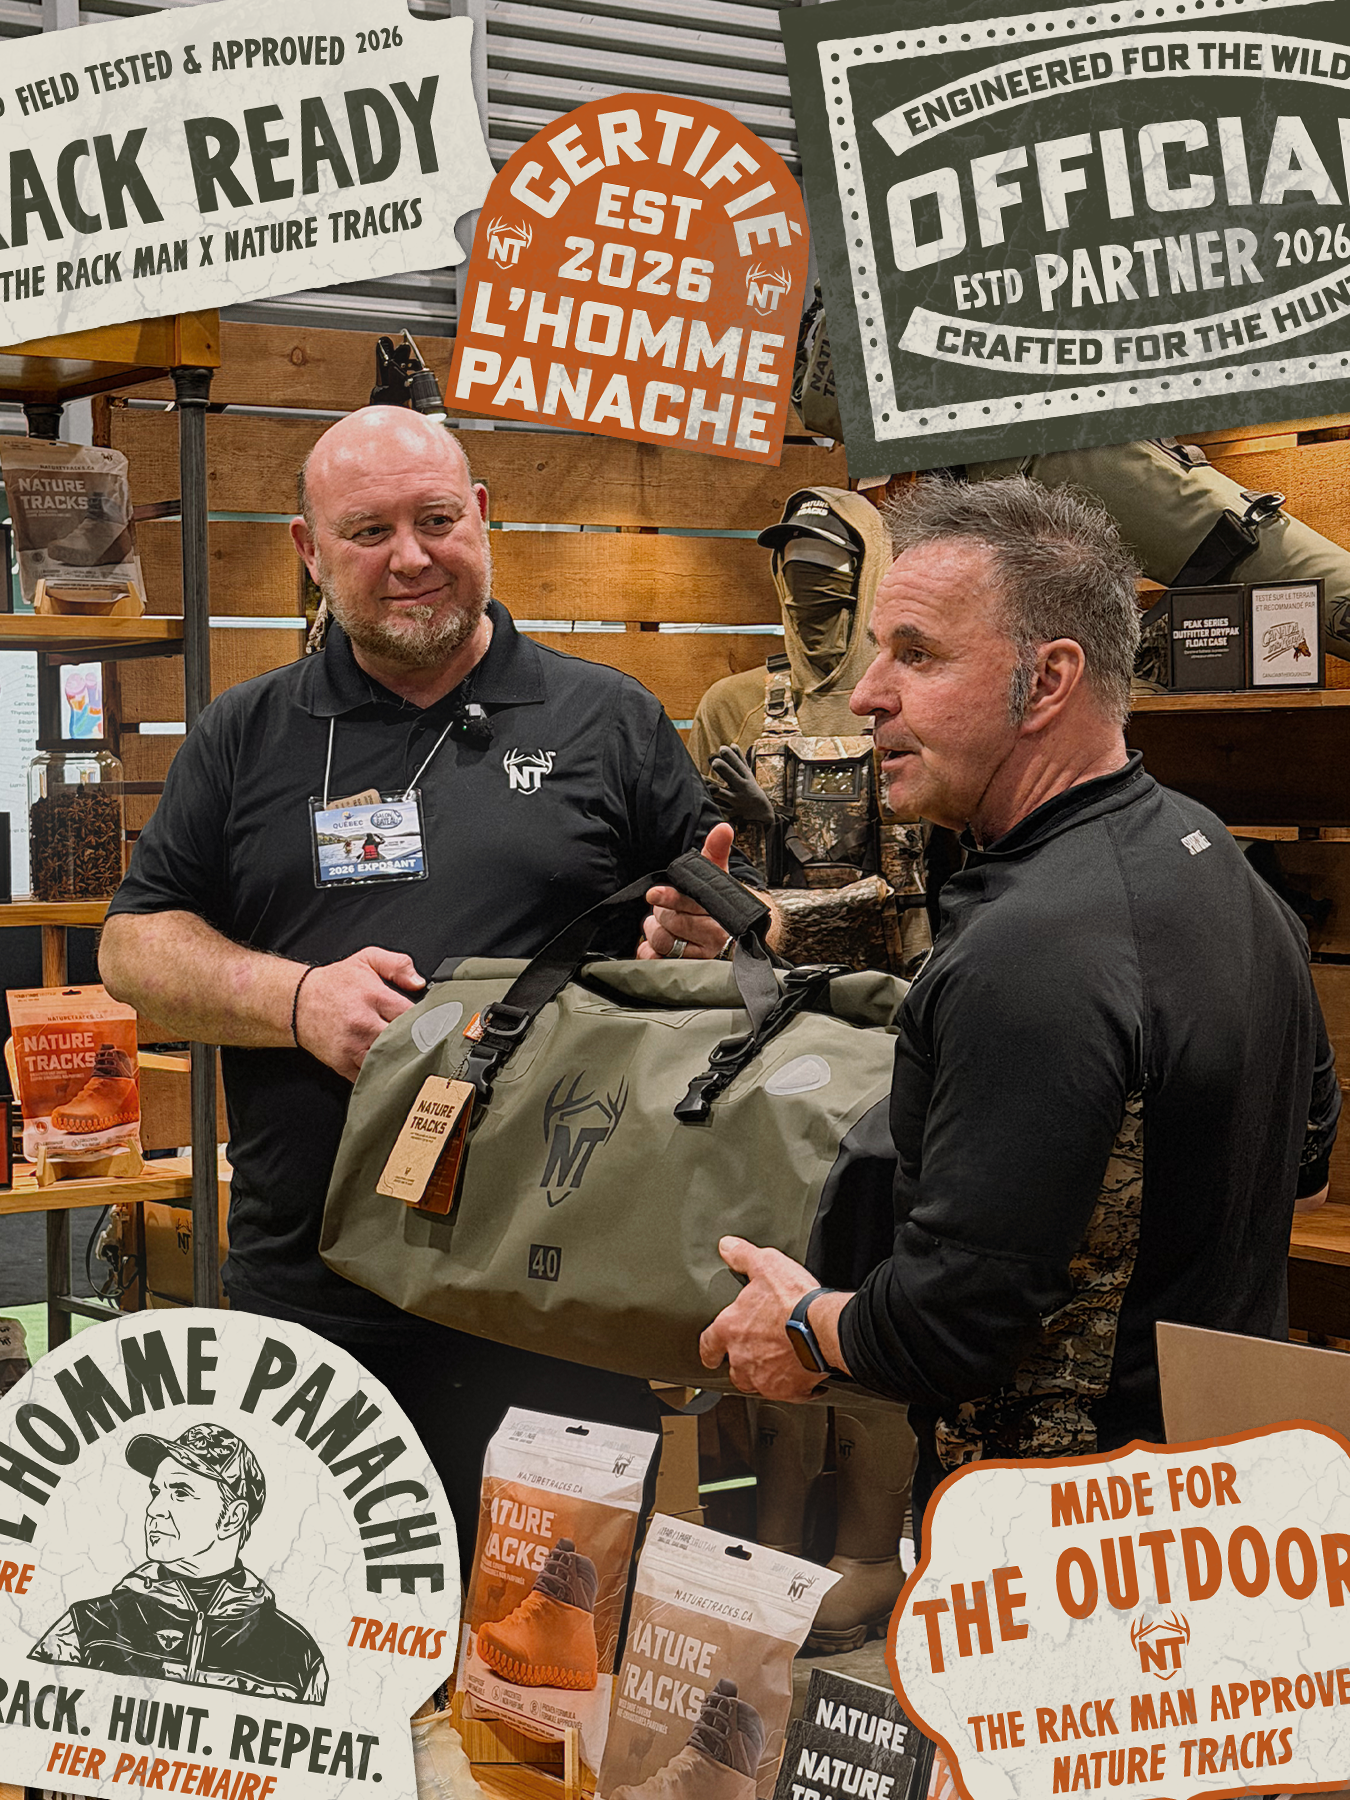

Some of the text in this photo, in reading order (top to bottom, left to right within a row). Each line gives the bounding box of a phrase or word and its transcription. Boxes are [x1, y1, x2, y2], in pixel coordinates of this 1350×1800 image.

[18, 478, 86, 492] NATURE
[20, 495, 88, 509] TRACKS
[1293, 591, 1315, 599] TERRAIN
[1173, 627, 1239, 639] OUTFITTER DRYPAK
[1183, 618, 1229, 629] PEAK SERIES
[1186, 637, 1228, 648] FLOAT CASE
[509, 765, 548, 789] NT
[328, 859, 416, 876] 2026 EXPOSANT
[23, 1032, 94, 1052] NATURE
[25, 1052, 96, 1072] TRACKS
[416, 1100, 455, 1118] NATURE
[410, 1116, 447, 1134] TRACKS
[540, 1124, 610, 1188] NT
[532, 1248, 558, 1278] 40
[517, 1471, 583, 1494] NATURETRACKS.CA
[485, 1532, 549, 1572] ACKS
[674, 1589, 754, 1623] NATURETRACKS.CA
[815, 1698, 908, 1755] NATURE
[796, 1748, 895, 1800] NATURE
